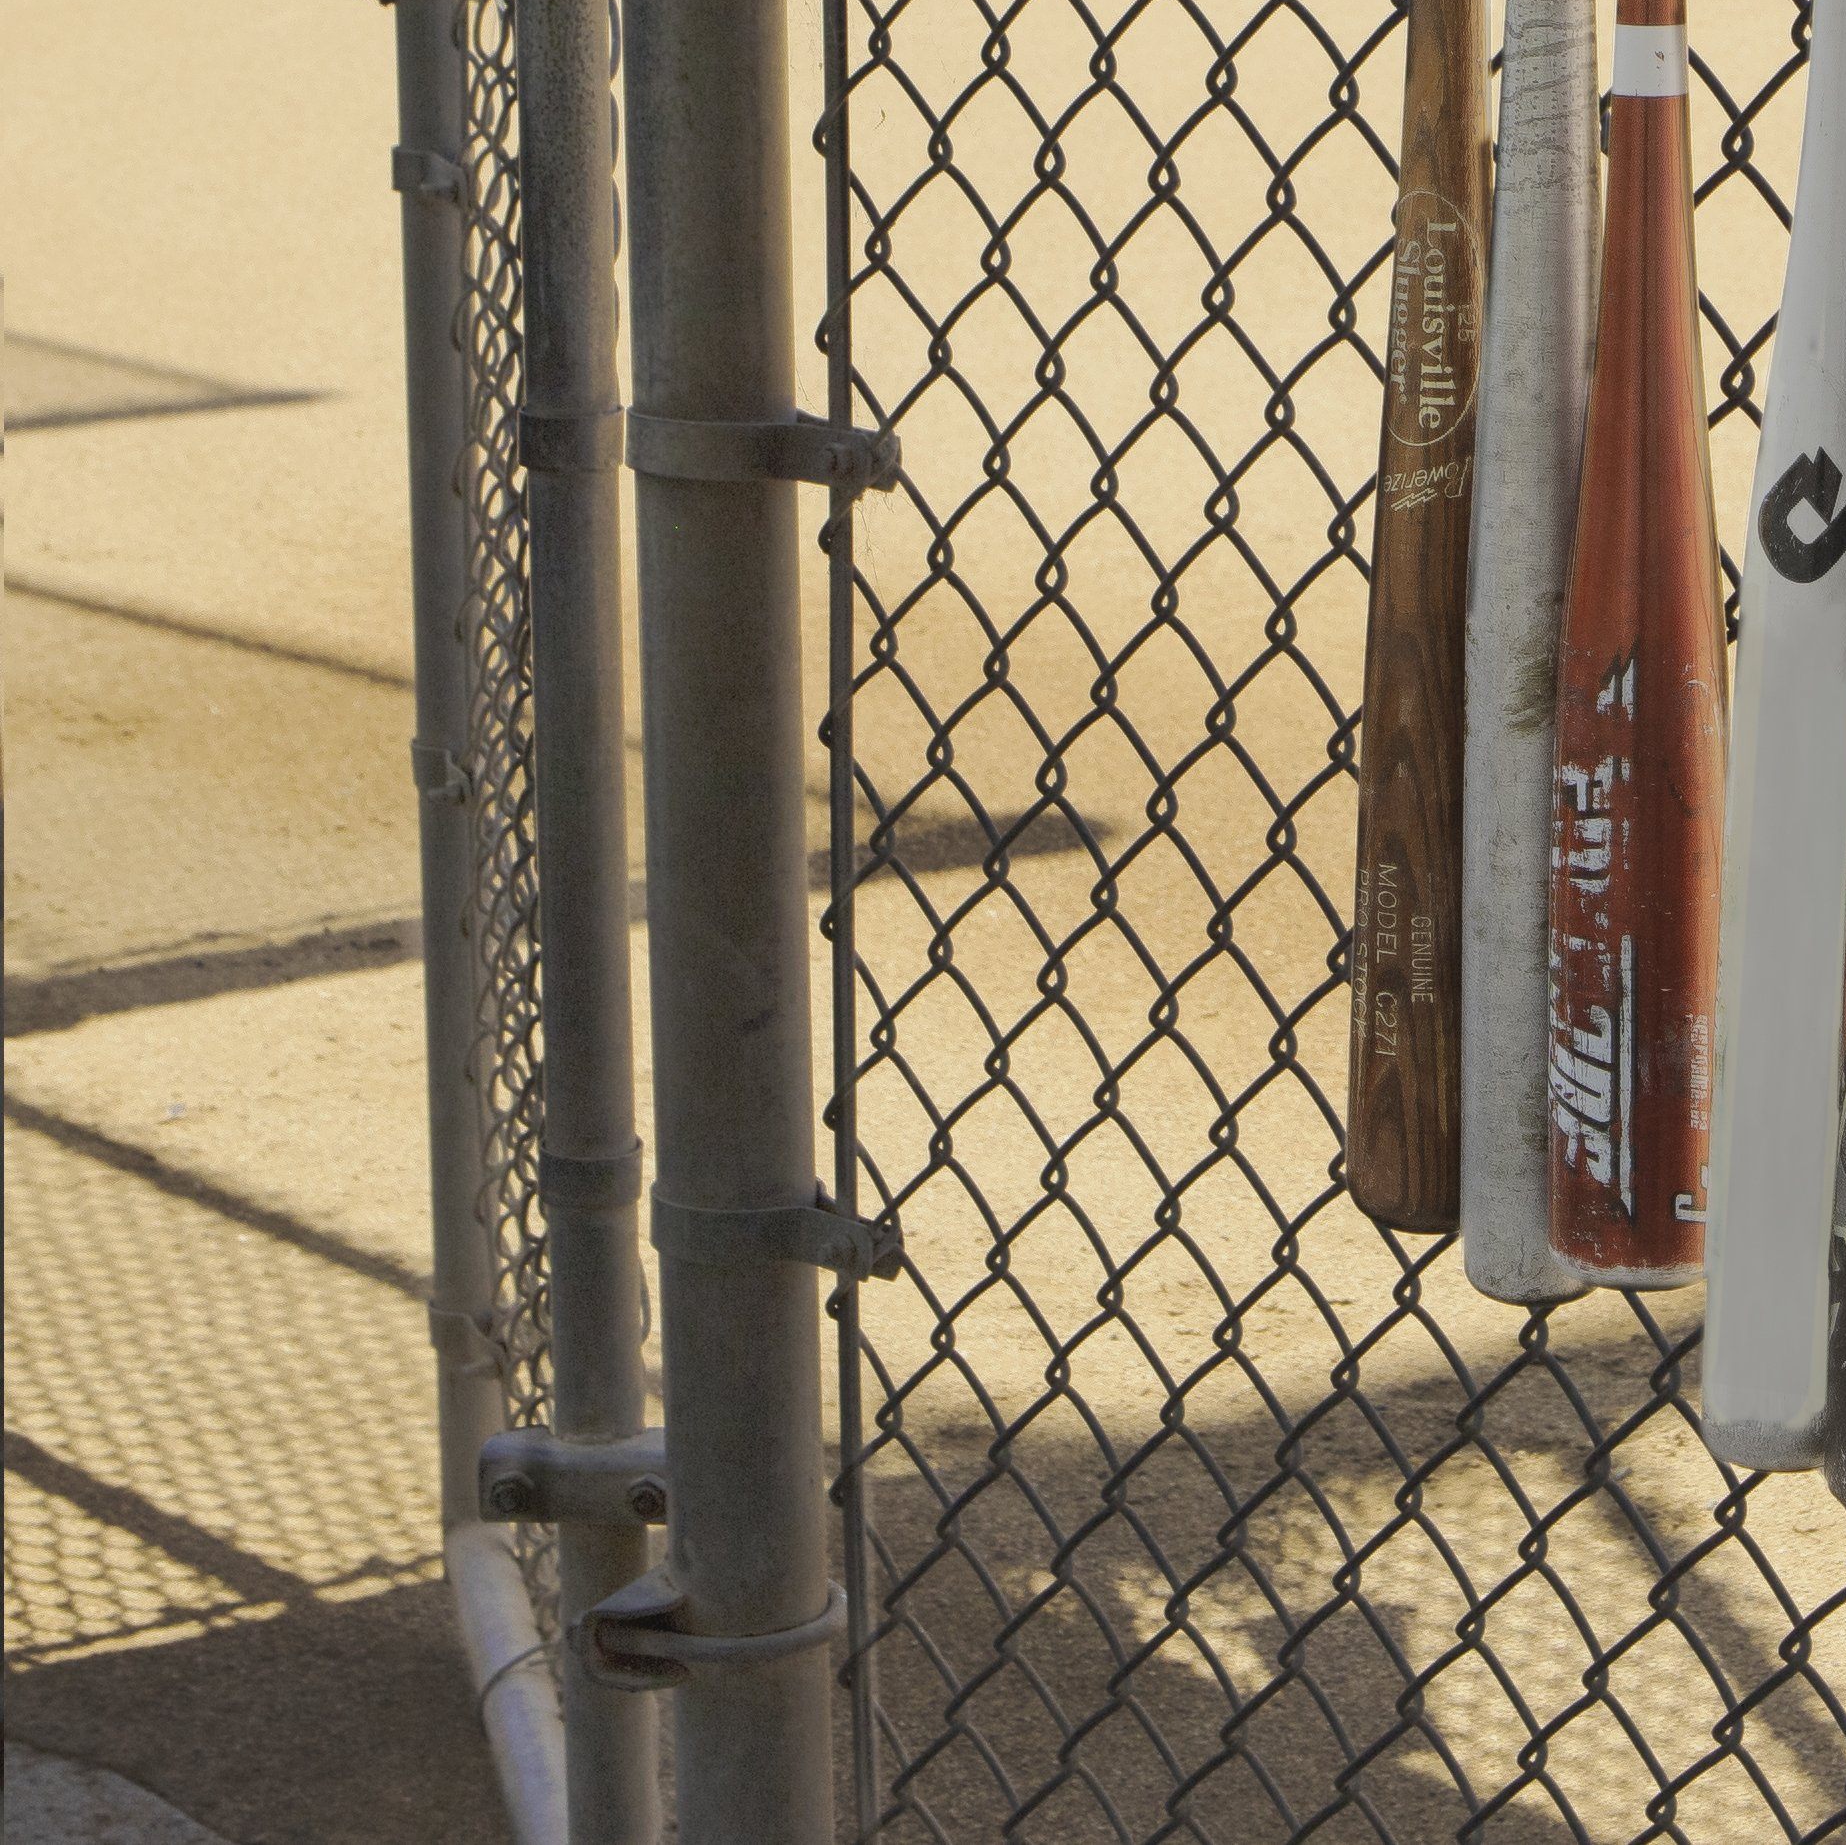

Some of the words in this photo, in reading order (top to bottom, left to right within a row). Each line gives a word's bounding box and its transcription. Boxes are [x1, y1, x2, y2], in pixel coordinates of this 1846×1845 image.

[1417, 217, 1458, 430] Louisville
[1375, 862, 1398, 965] MODEL
[1410, 915, 1434, 1005] GENUINE
[1374, 991, 1398, 1057] C271
